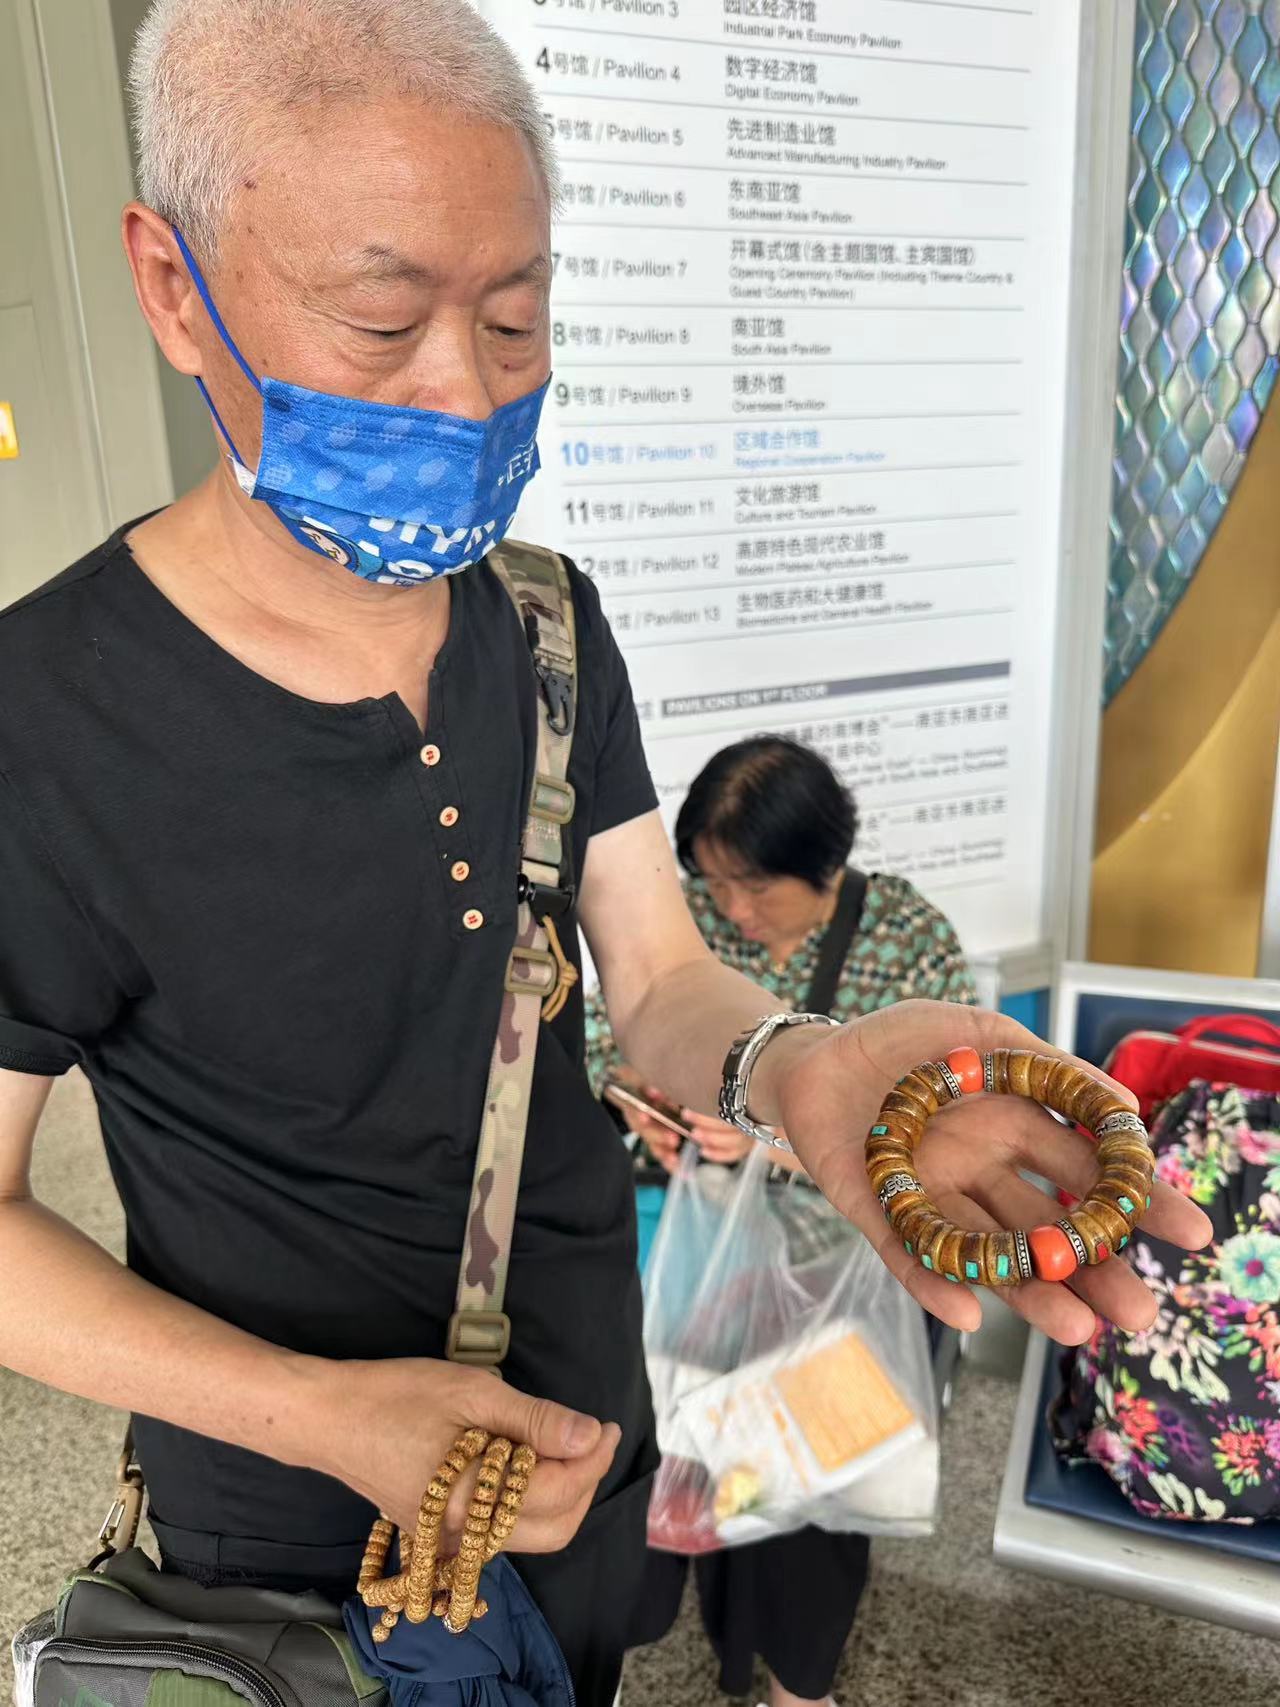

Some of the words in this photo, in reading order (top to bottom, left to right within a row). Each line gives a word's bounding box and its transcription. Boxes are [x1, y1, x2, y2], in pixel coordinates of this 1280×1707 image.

[669, 3, 680, 18] 3
[724, 22, 774, 38] Industrial
[778, 26, 803, 40] Park
[807, 28, 856, 47] Economy
[860, 33, 902, 49] Pavilion
[536, 47, 588, 75] 4号馆
[604, 58, 667, 80] Pavilion
[670, 66, 682, 82] 4
[725, 55, 818, 84] 数字经济馆
[725, 84, 759, 101] Digital
[764, 87, 814, 105] Economy
[817, 91, 860, 106] Pavilion
[607, 123, 670, 145] Pavilion
[672, 128, 684, 146] 5
[727, 119, 836, 146] 先进制造业馆
[906, 155, 947, 170] Pavilion
[609, 187, 672, 208] Pavilion
[674, 190, 687, 209] 6
[728, 180, 801, 203] 东南亚馆
[551, 252, 599, 278] 7号馆
[612, 258, 673, 278] Pavilion
[676, 260, 688, 278] 7
[552, 322, 602, 346] 8号馆
[616, 327, 675, 345] Pavilion
[555, 382, 606, 407] 9号馆
[618, 387, 676, 403] Pavilion
[562, 441, 624, 467] 10号馆
[638, 446, 696, 462] Pavilion
[564, 499, 624, 525] 11号馆
[638, 502, 696, 519] Pavilion
[642, 557, 697, 573] Pavilion
[643, 609, 700, 626] Pavilion
